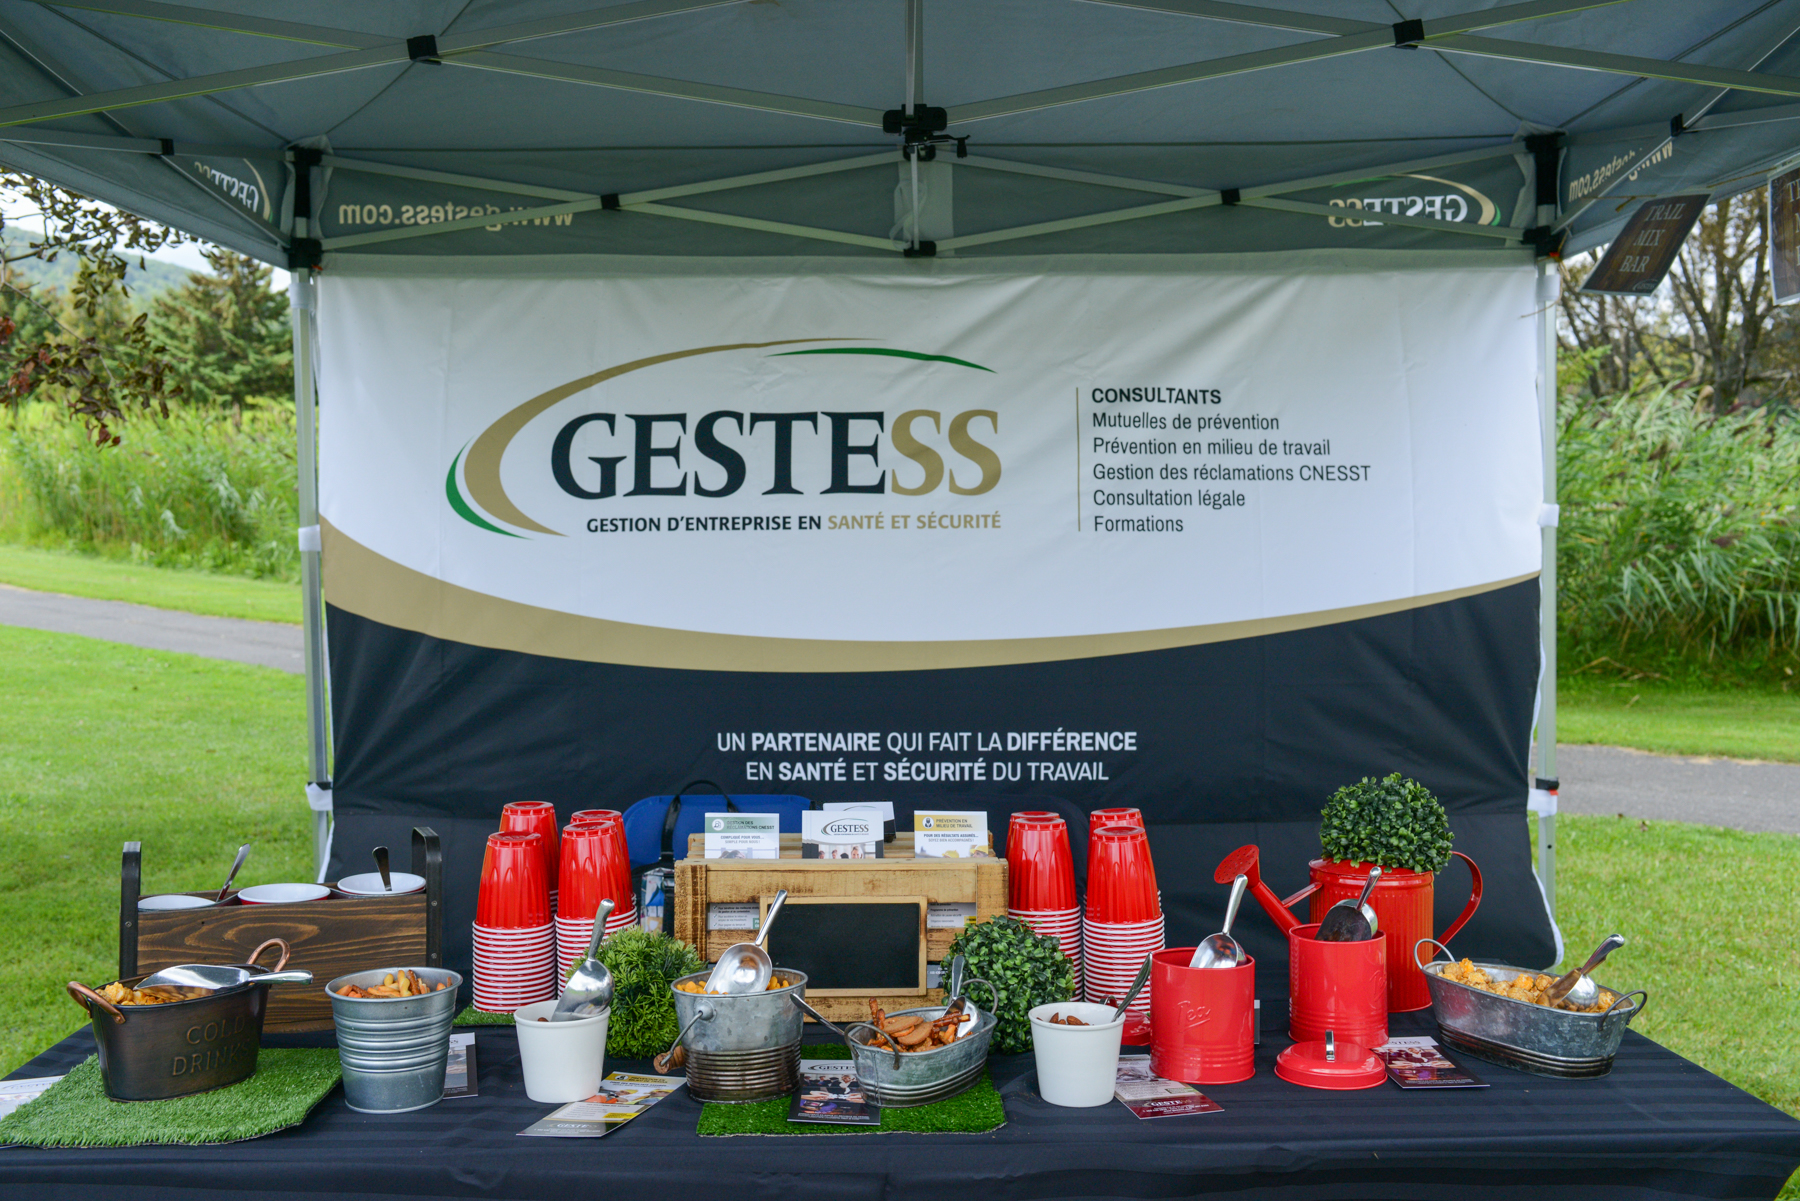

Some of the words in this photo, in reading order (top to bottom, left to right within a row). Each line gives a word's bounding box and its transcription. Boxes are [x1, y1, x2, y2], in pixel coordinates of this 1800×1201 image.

[1645, 203, 1686, 221] TRAIL
[1633, 229, 1665, 246] MIX
[1619, 255, 1650, 272] BAR
[1091, 387, 1222, 404] CONSULTANTS
[1092, 412, 1167, 429] Mutuelles
[1172, 413, 1192, 429] de
[1197, 413, 1280, 433] prévention
[551, 409, 1002, 500] GESTESS
[1093, 437, 1177, 455] Prévention
[1182, 442, 1201, 455] en
[1207, 438, 1253, 455] milieu
[1258, 439, 1278, 455] de
[1282, 439, 1331, 456] travail
[1093, 463, 1154, 480] Gestion
[1159, 463, 1188, 480] des
[1193, 464, 1294, 481] réclamations
[1299, 465, 1371, 481] CNESST
[1093, 489, 1193, 506] Consultation
[1198, 489, 1246, 510] légale
[587, 516, 661, 533] GESTION
[667, 515, 792, 532] D'ENTREPRISE
[798, 515, 822, 530] EN
[827, 511, 885, 530] SANTÉ
[891, 514, 911, 529] ET
[916, 510, 1002, 529] SÉCURITÉ
[1094, 515, 1184, 532] Formations
[717, 732, 746, 751] UN
[751, 732, 880, 751] PARTENAIRE
[886, 732, 923, 754] QUI
[929, 732, 972, 751] FAIT
[977, 732, 1002, 751] LA
[1006, 727, 1138, 751] DIFFÉRENCE
[746, 762, 774, 780] EN
[778, 757, 847, 781] SANTÉ
[853, 762, 878, 780] ET
[884, 757, 987, 781] SÉCURITÉ
[993, 762, 1021, 781] DU
[1027, 762, 1109, 781] TRAVAIL
[830, 824, 869, 833] GESTESS
[1177, 1000, 1212, 1032] Tea
[186, 1015, 246, 1045] COLD
[172, 1040, 250, 1076] DRINKS
